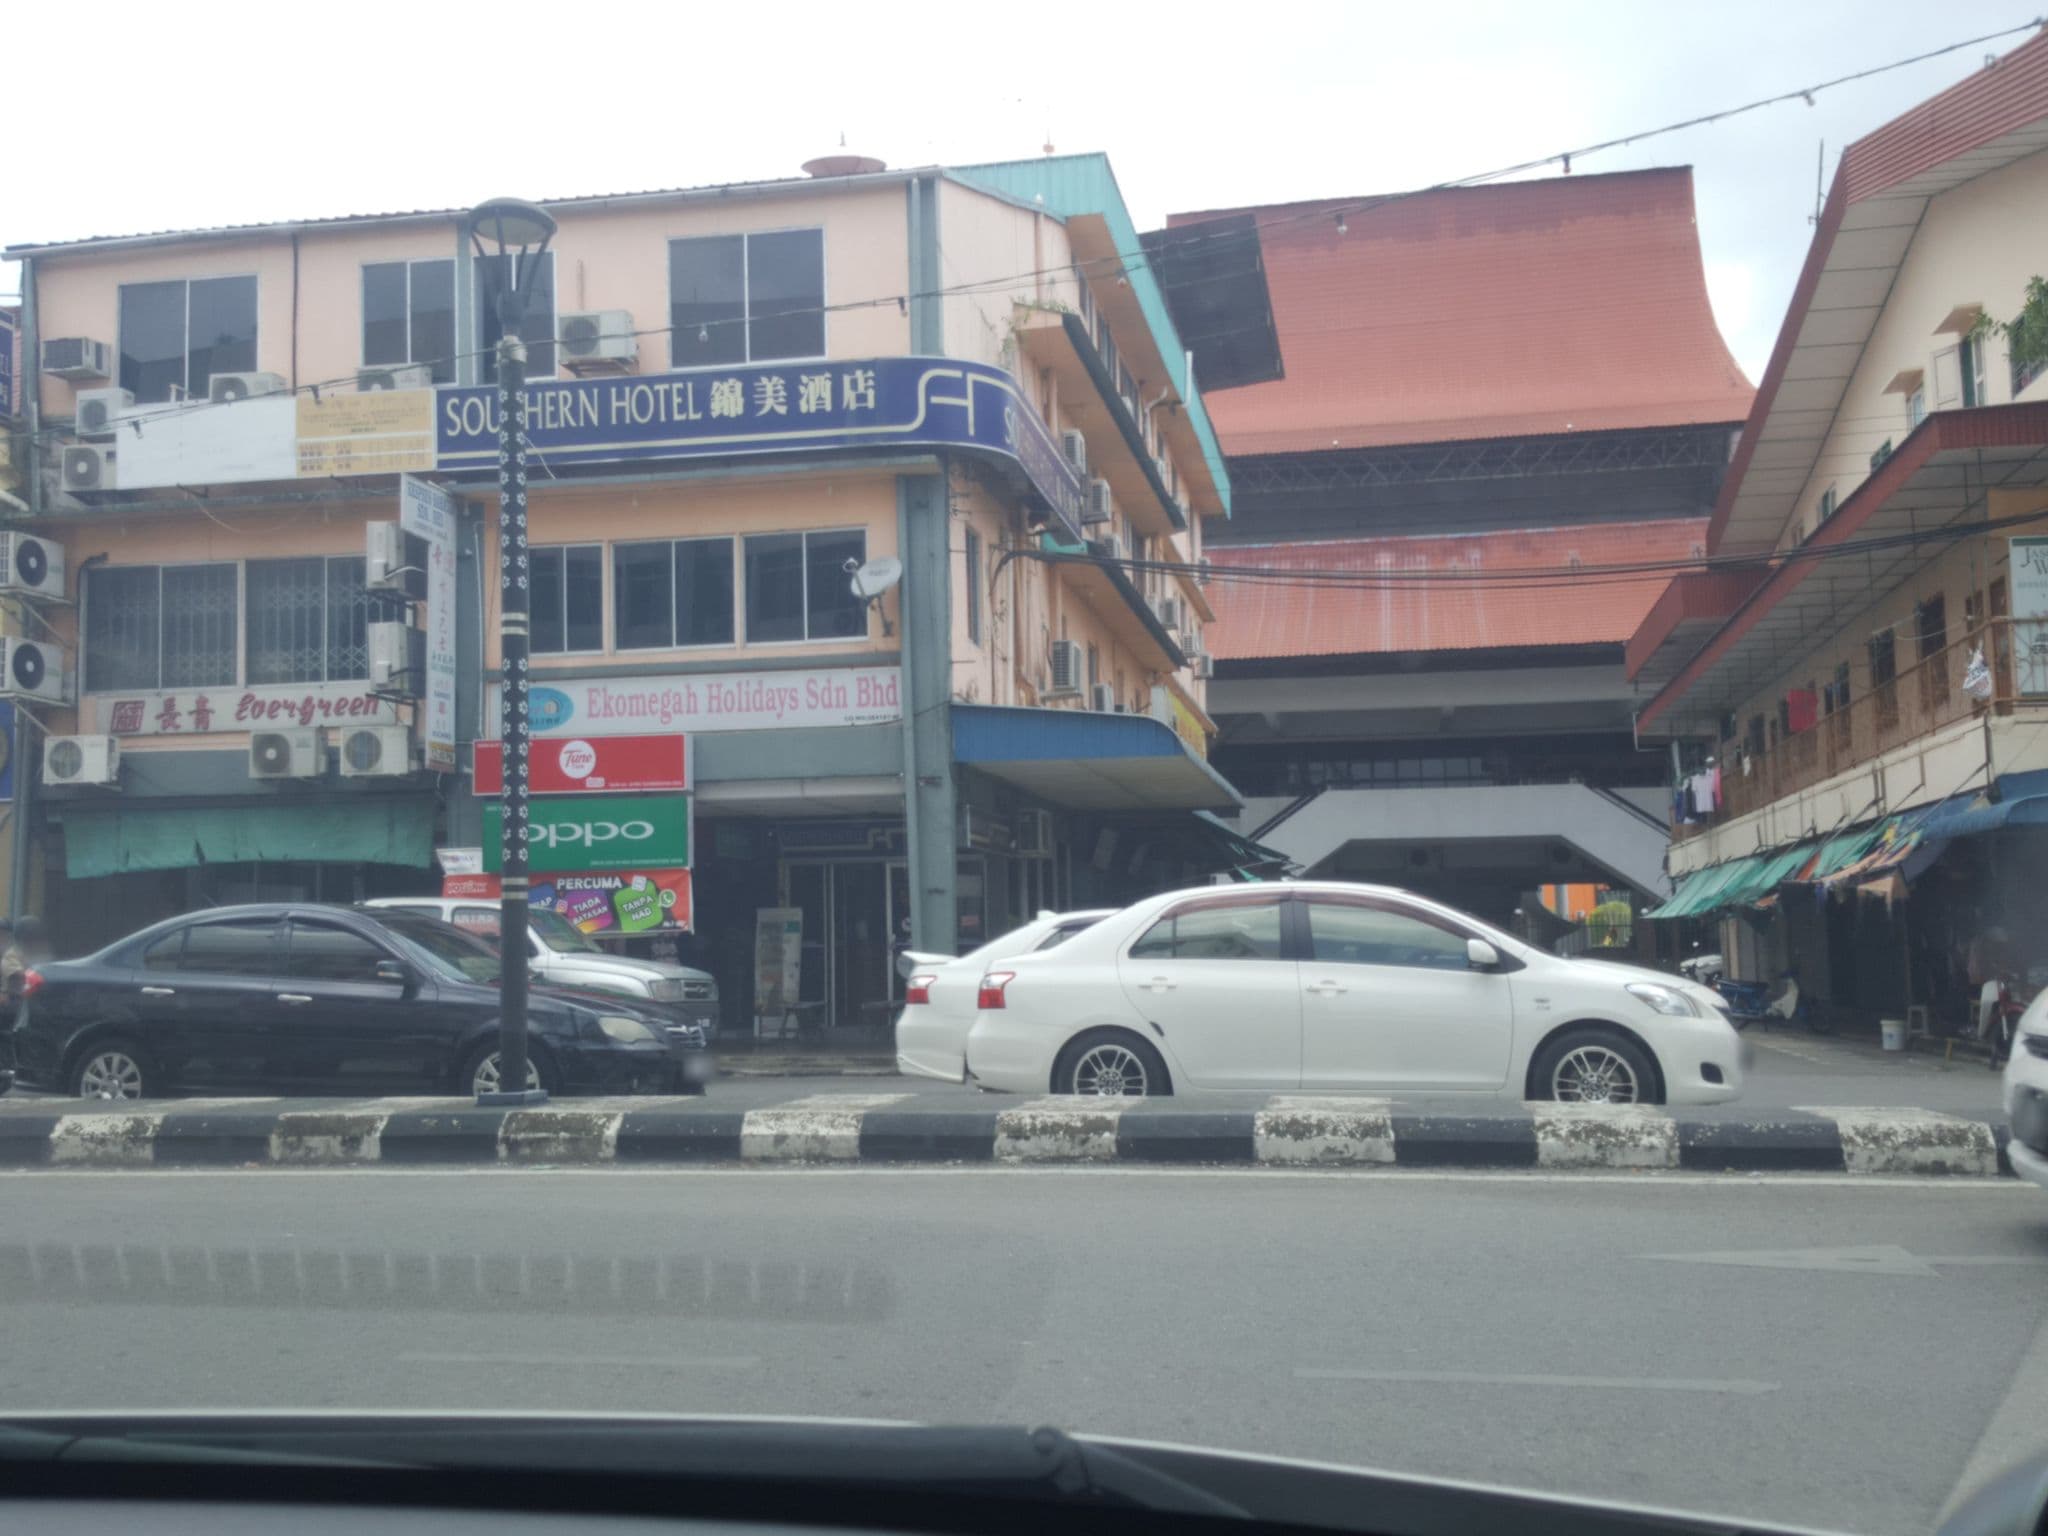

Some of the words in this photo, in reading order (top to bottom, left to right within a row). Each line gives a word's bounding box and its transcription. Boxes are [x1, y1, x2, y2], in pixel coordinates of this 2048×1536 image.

[446, 387, 599, 437] SOUHERN
[611, 381, 702, 425] HOTEL
[710, 369, 876, 419] 錦美酒店
[587, 683, 698, 724] Ekomegah
[706, 677, 799, 720] Holidays
[806, 677, 849, 711] Sdn
[856, 674, 899, 708] Bhd
[563, 749, 593, 768] Tune
[556, 876, 623, 891] PERCUMA
[622, 894, 654, 913] TANPA
